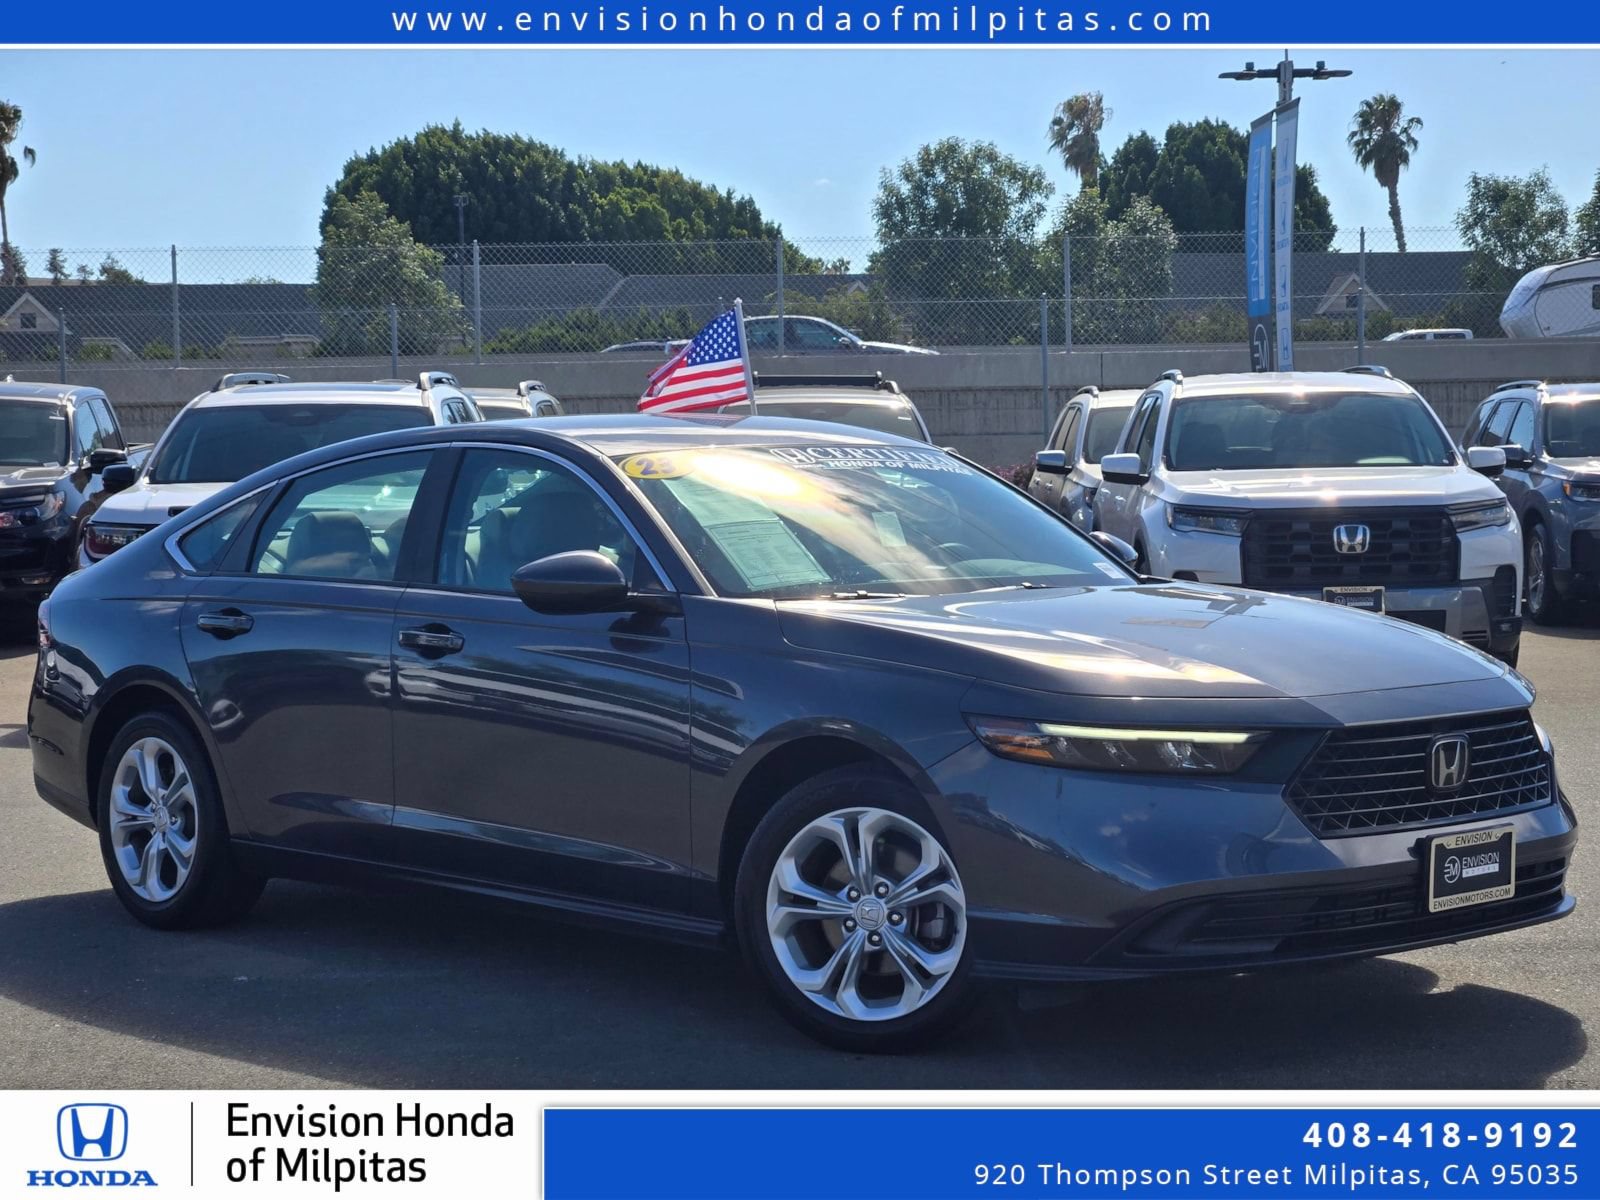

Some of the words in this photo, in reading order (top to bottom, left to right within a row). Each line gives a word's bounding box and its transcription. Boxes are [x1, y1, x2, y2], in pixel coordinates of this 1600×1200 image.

[829, 460, 884, 468] HONDA
[885, 461, 904, 469] OF
[1455, 831, 1493, 846] ENVISION
[1462, 852, 1500, 869] ENVISION
[1433, 887, 1511, 910] ENVISIONMOTORS.COM
